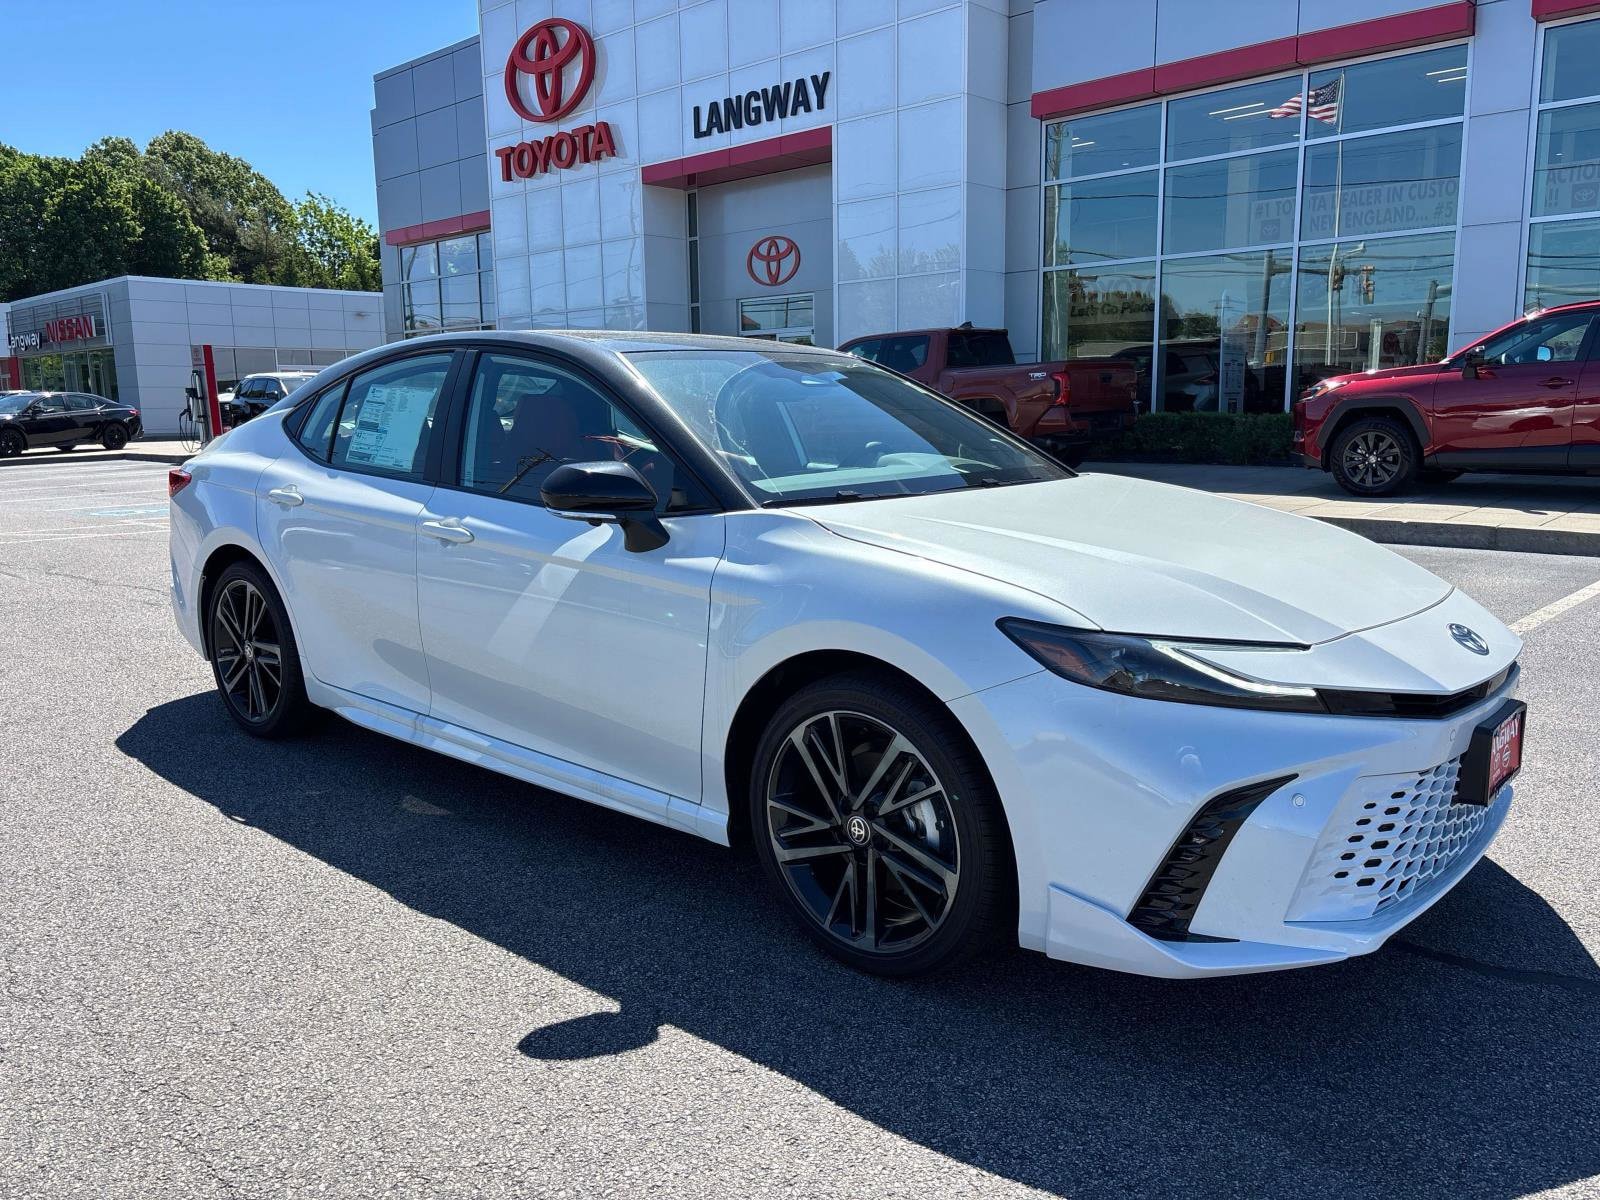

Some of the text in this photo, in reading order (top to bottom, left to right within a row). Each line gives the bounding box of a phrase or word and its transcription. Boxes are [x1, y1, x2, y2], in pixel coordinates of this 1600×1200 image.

[693, 71, 830, 139] LANGWAY
[495, 120, 617, 182] TOYOTA
[1386, 184, 1404, 204] IN
[1407, 180, 1457, 201] CUSTO
[1101, 302, 1119, 315] Go
[1120, 301, 1155, 315] Place
[8, 331, 42, 351] Langway
[46, 315, 96, 342] NISSAN
